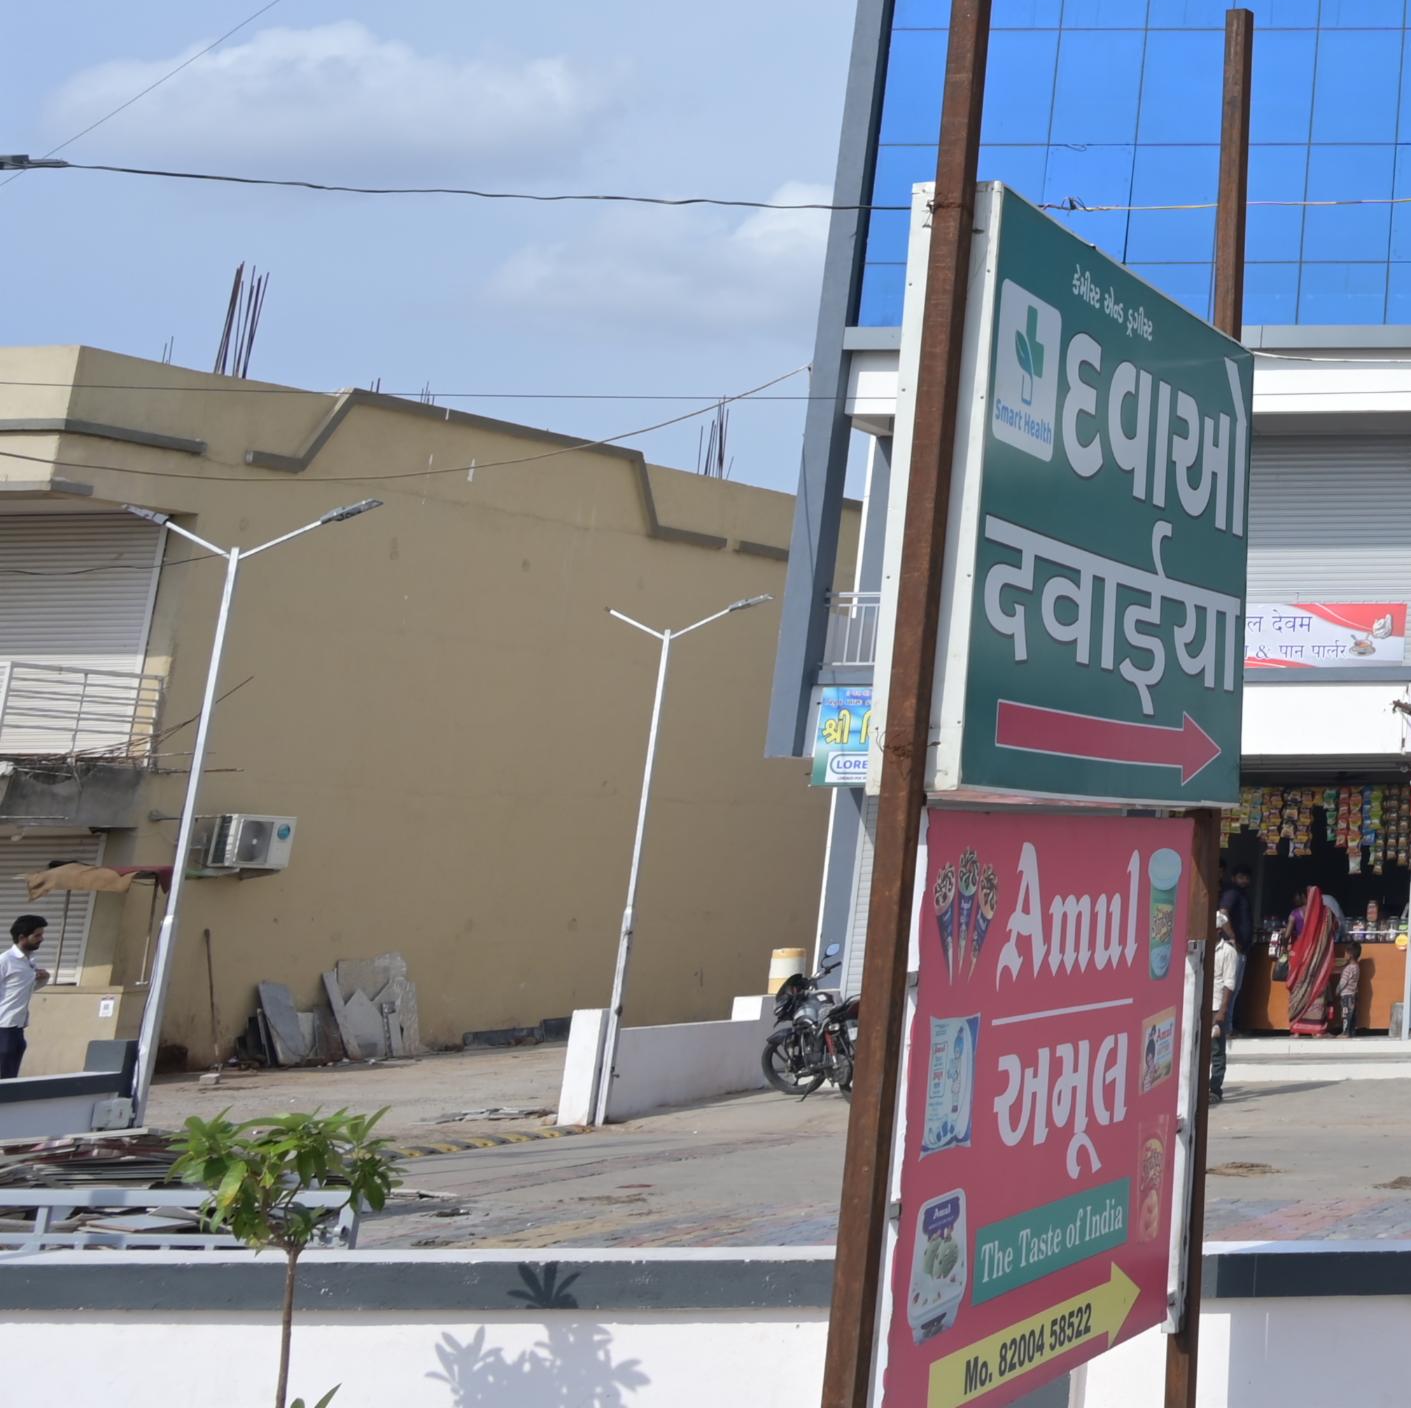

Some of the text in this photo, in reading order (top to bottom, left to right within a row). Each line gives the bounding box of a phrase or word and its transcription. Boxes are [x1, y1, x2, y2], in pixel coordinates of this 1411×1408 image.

[995, 398, 1052, 445] Smart Health
[1062, 332, 1246, 537] દવાઓ
[1256, 645, 1270, 659] &
[1279, 644, 1304, 658] पान
[1271, 609, 1313, 633] देवम
[996, 841, 1140, 990] Amul
[993, 1032, 1128, 1179] અમૂલ
[980, 1203, 1124, 1284] The Taste of India
[964, 1303, 1093, 1395] Mo. 82004 58522
